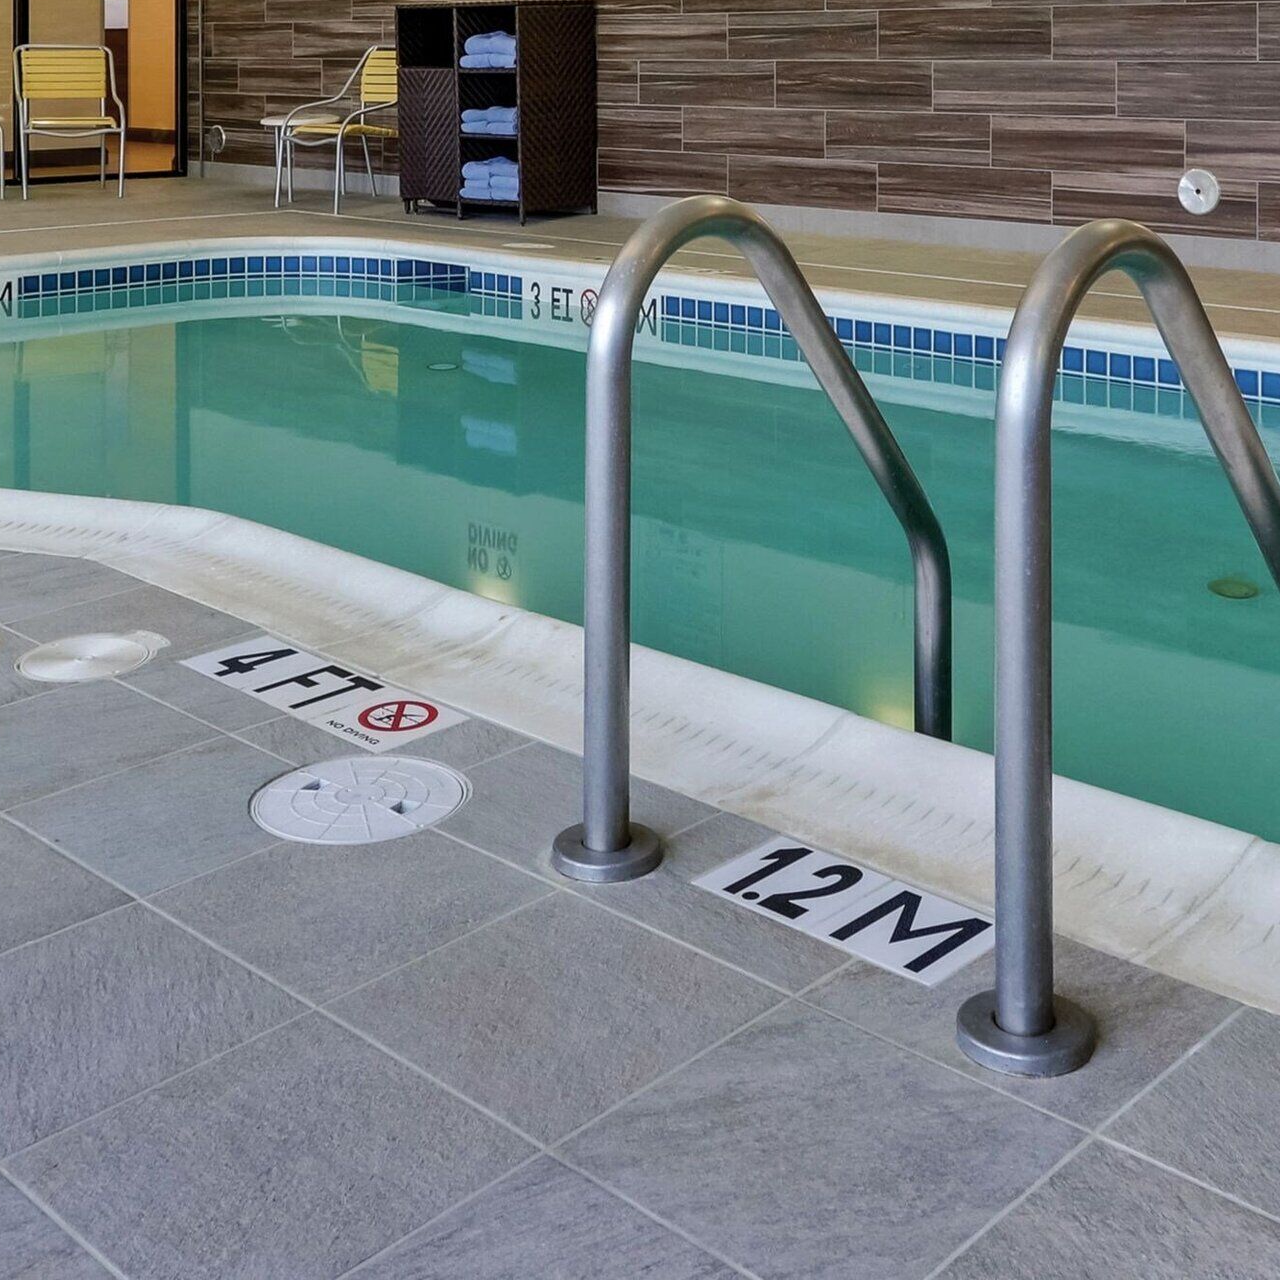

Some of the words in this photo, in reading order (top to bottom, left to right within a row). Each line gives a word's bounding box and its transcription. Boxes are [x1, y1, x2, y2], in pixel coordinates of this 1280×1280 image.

[214, 648, 299, 677] 4
[253, 665, 385, 710] FT
[326, 720, 345, 729] NO
[343, 727, 380, 745] DIVING
[721, 847, 864, 920] 1.2
[827, 889, 994, 974] M
